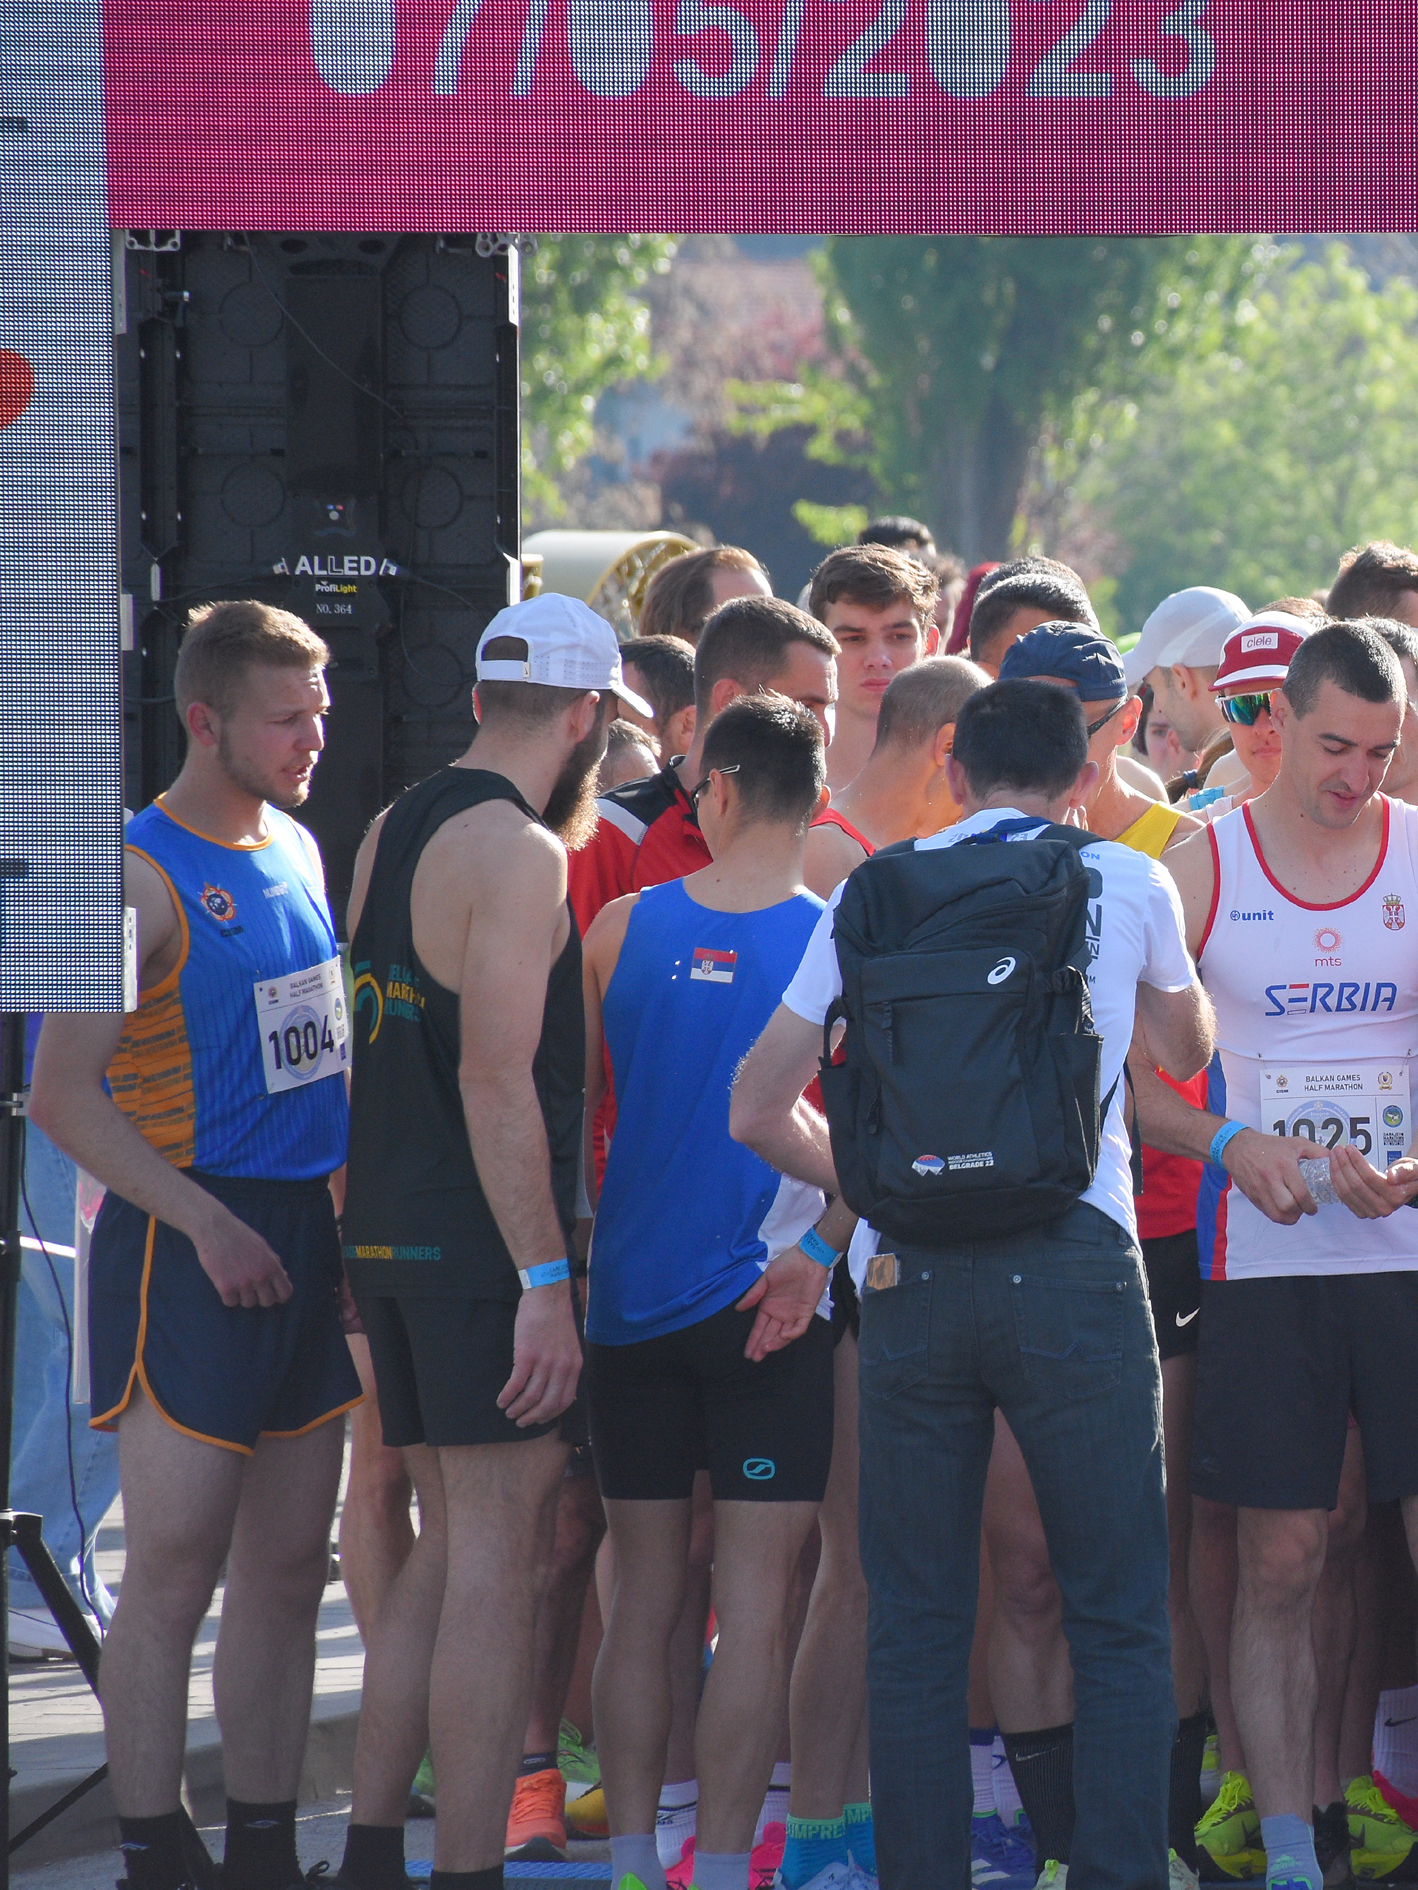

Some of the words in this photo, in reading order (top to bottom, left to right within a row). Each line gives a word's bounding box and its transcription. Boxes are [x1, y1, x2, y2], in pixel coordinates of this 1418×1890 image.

[294, 555, 377, 576] ALLED
[315, 582, 358, 593] ProfiLight
[334, 603, 353, 614] 364
[1241, 910, 1275, 921] unit
[1314, 956, 1342, 967] mts
[1264, 982, 1398, 1016] SERBIA
[268, 1014, 335, 1070] 1004
[1305, 1075, 1335, 1083] BALKAN
[1336, 1074, 1361, 1082] GAMES
[1324, 1083, 1363, 1091] MARATHON
[949, 1161, 984, 1170] BELGRADE
